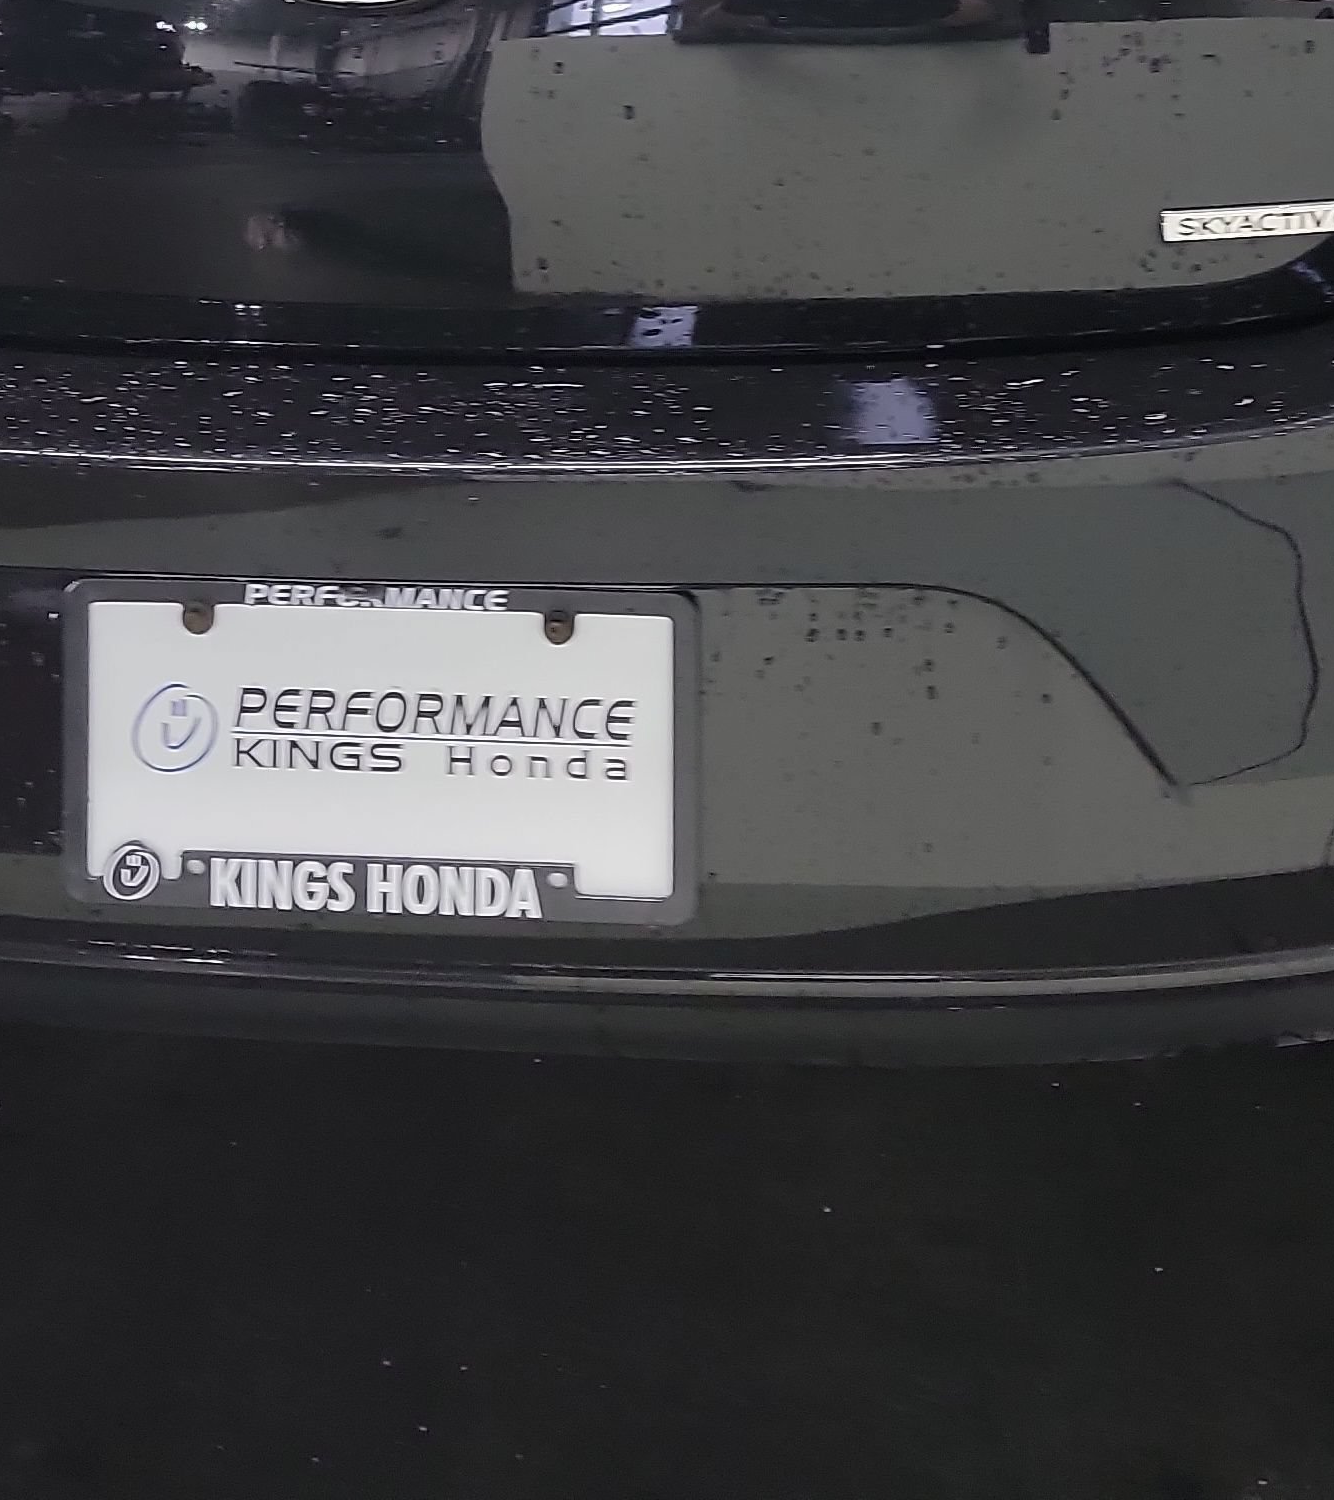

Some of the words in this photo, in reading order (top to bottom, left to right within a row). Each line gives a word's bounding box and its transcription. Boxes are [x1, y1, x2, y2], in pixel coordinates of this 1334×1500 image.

[1178, 208, 1330, 235] SKYACTIV
[234, 686, 637, 741] PERFORMANCE
[233, 738, 404, 773] KINGS
[447, 745, 628, 781] Honda
[210, 857, 356, 912] KINGS
[366, 863, 543, 919] HONDA
